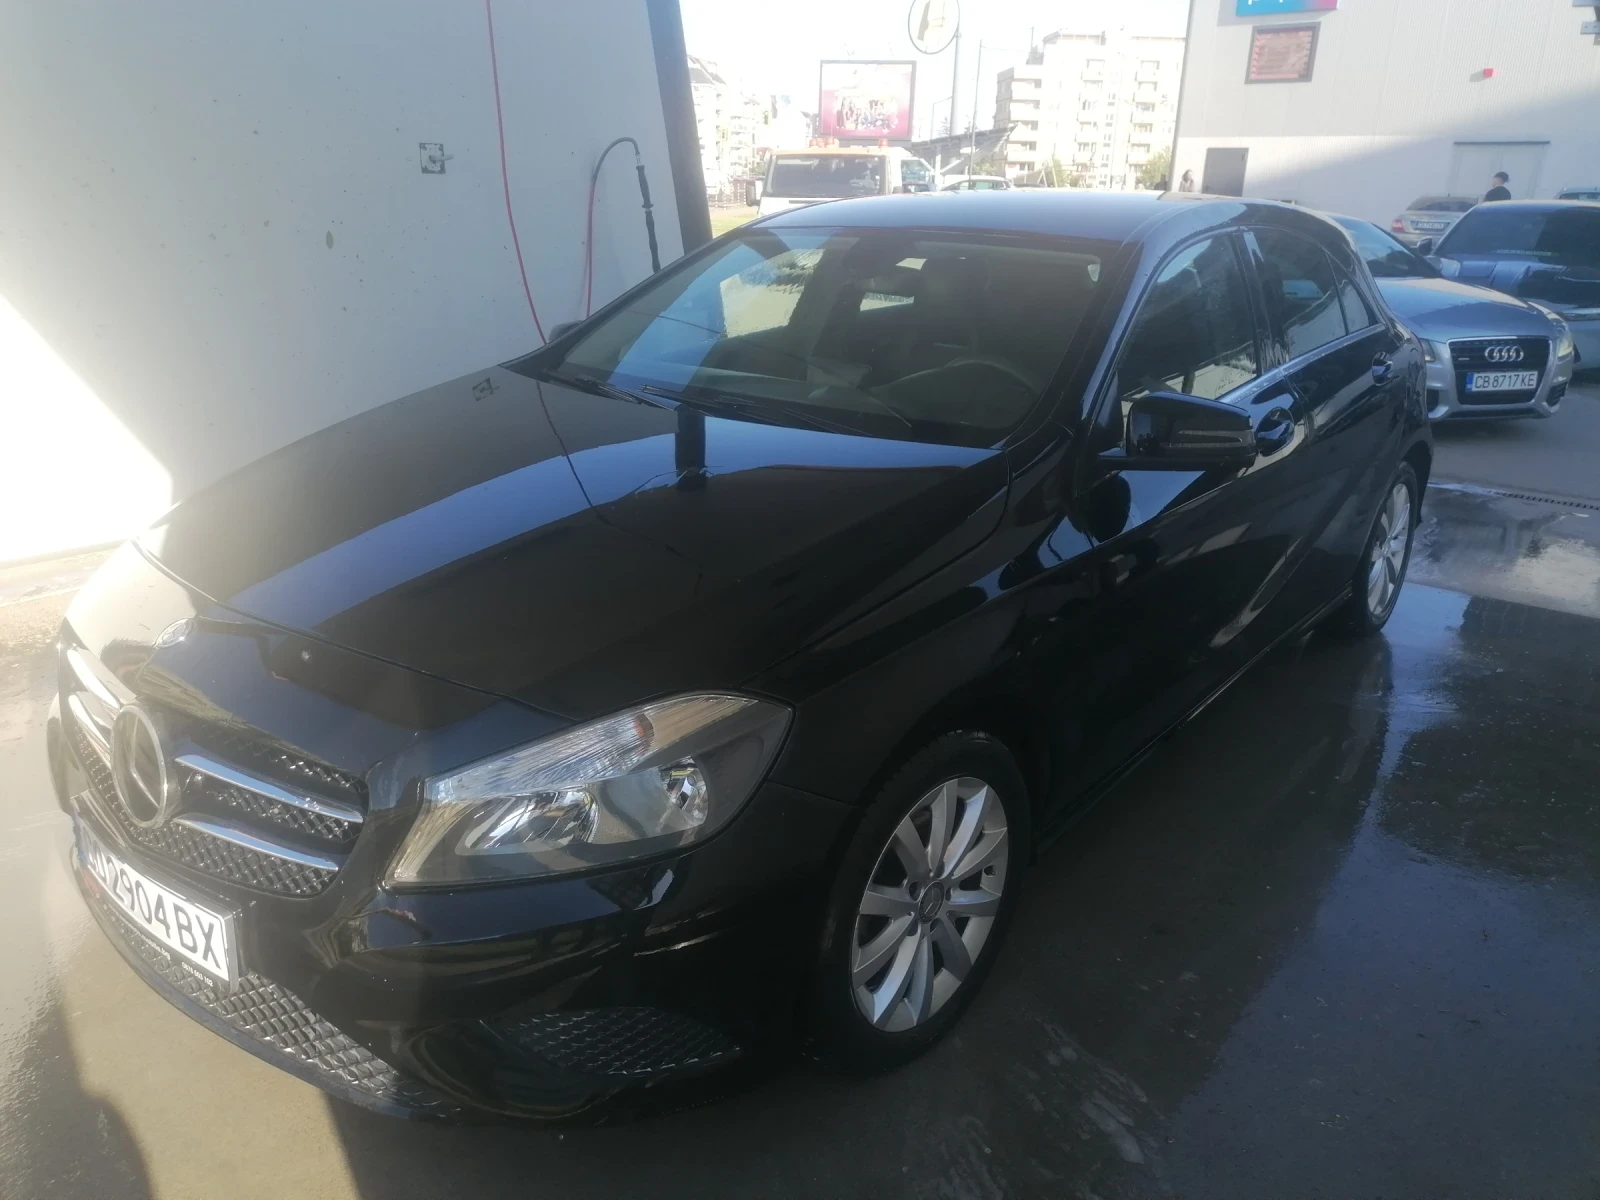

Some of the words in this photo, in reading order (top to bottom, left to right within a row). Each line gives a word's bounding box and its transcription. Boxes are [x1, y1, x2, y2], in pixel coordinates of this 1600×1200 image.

[1474, 375, 1490, 389] CB
[1491, 374, 1520, 388] 8717
[1520, 373, 1535, 387] KE
[107, 855, 171, 939] 2904
[172, 901, 222, 970] BX
